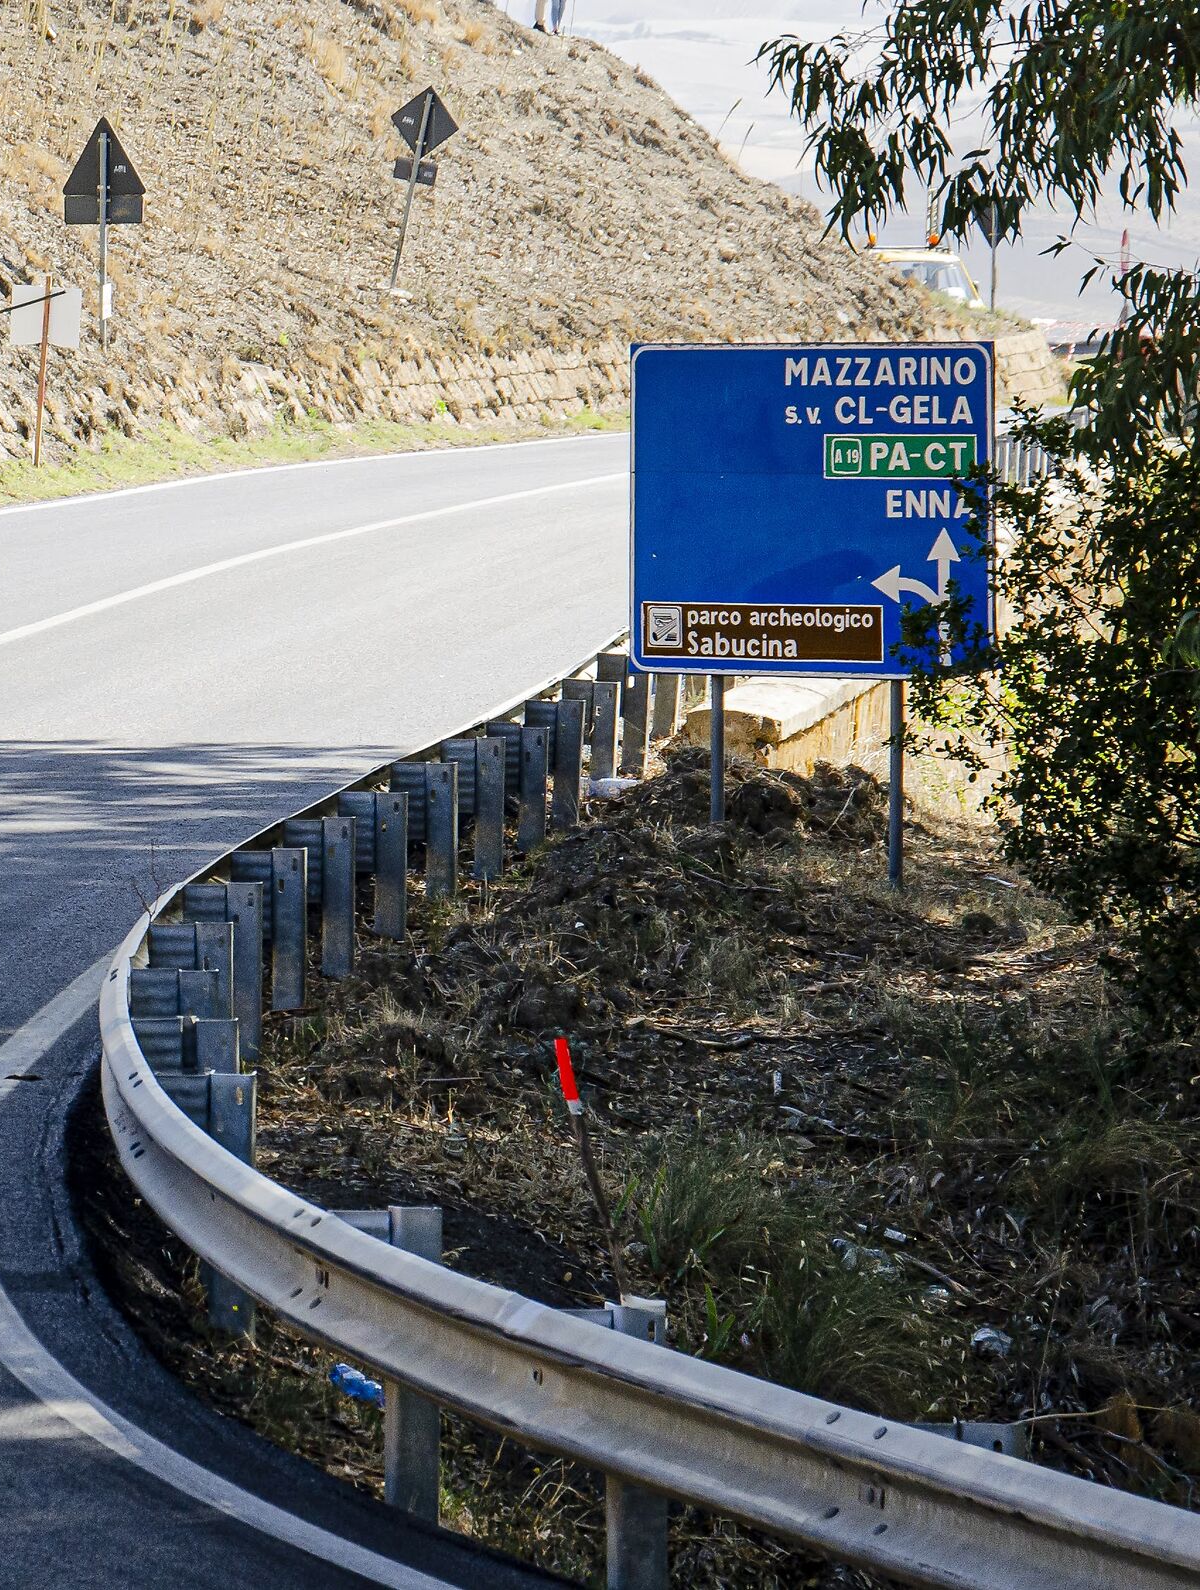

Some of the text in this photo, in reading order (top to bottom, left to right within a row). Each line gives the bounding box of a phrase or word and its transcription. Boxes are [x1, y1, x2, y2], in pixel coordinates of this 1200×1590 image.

[785, 356, 977, 386] MAZZARINO
[834, 395, 974, 425] CL-GELA
[870, 442, 967, 471] PA-CT
[687, 608, 874, 633] parco archeologico
[687, 630, 798, 657] Sabucina
